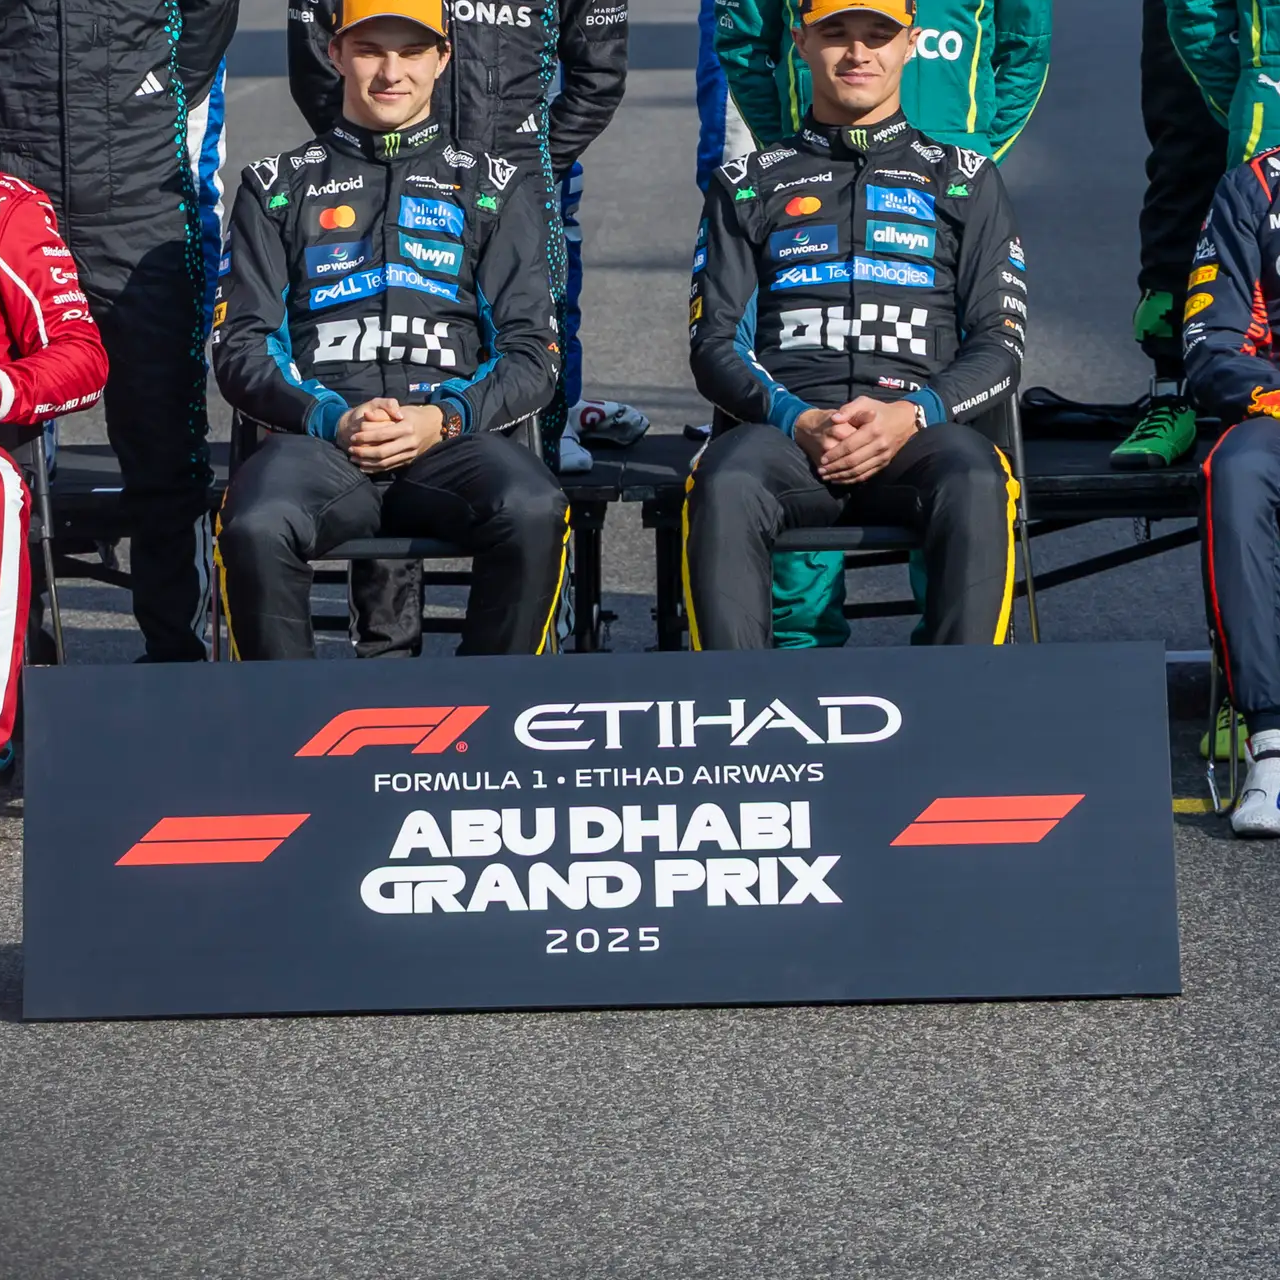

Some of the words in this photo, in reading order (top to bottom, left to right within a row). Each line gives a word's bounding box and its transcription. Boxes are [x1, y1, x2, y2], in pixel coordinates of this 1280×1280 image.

[586, 11, 628, 25] BONVOY
[306, 176, 363, 197] Android
[774, 172, 832, 192] Android
[885, 201, 917, 214] CISCO
[415, 216, 445, 226] CISCO
[874, 228, 929, 248] allwyn
[405, 242, 455, 265] allwyn
[780, 247, 795, 257] DP
[793, 243, 828, 254] WORLD
[317, 262, 333, 273] DP
[331, 256, 364, 271] WORLD
[315, 278, 361, 303] DELL
[953, 390, 990, 415] RICHARD
[989, 377, 1010, 397] MILLE
[294, 705, 490, 756] F1
[514, 695, 902, 750] ETIHAD
[375, 771, 521, 792] FORMULA
[533, 771, 547, 788] 1
[576, 767, 684, 787] ETIHAD
[692, 763, 824, 784] AIRWAYS
[389, 807, 555, 859] ABU
[570, 801, 811, 854] DHABI
[360, 860, 642, 914] GRAND
[655, 855, 843, 908] PRIX
[546, 927, 659, 953] 2025
